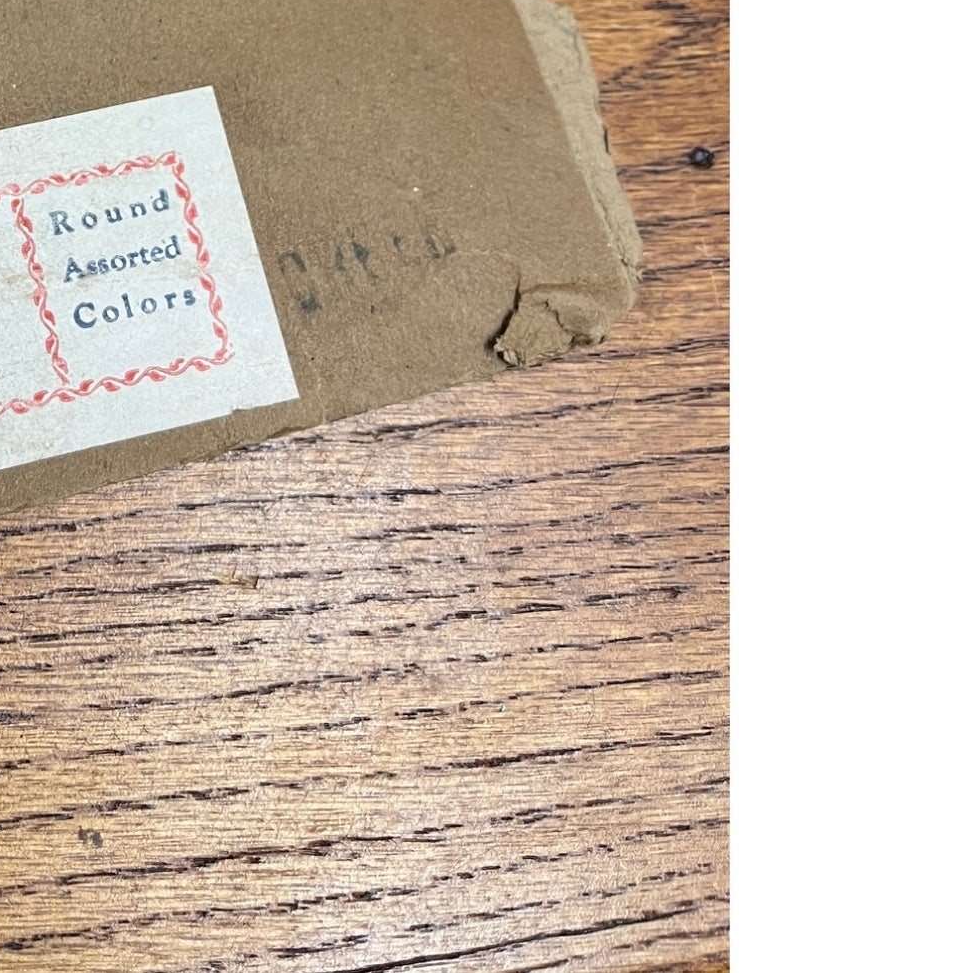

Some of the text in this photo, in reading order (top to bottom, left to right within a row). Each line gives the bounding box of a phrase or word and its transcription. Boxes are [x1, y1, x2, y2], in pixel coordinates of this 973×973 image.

[48, 188, 169, 235] Round
[63, 235, 181, 282] Assorted
[73, 287, 196, 328] Colors
